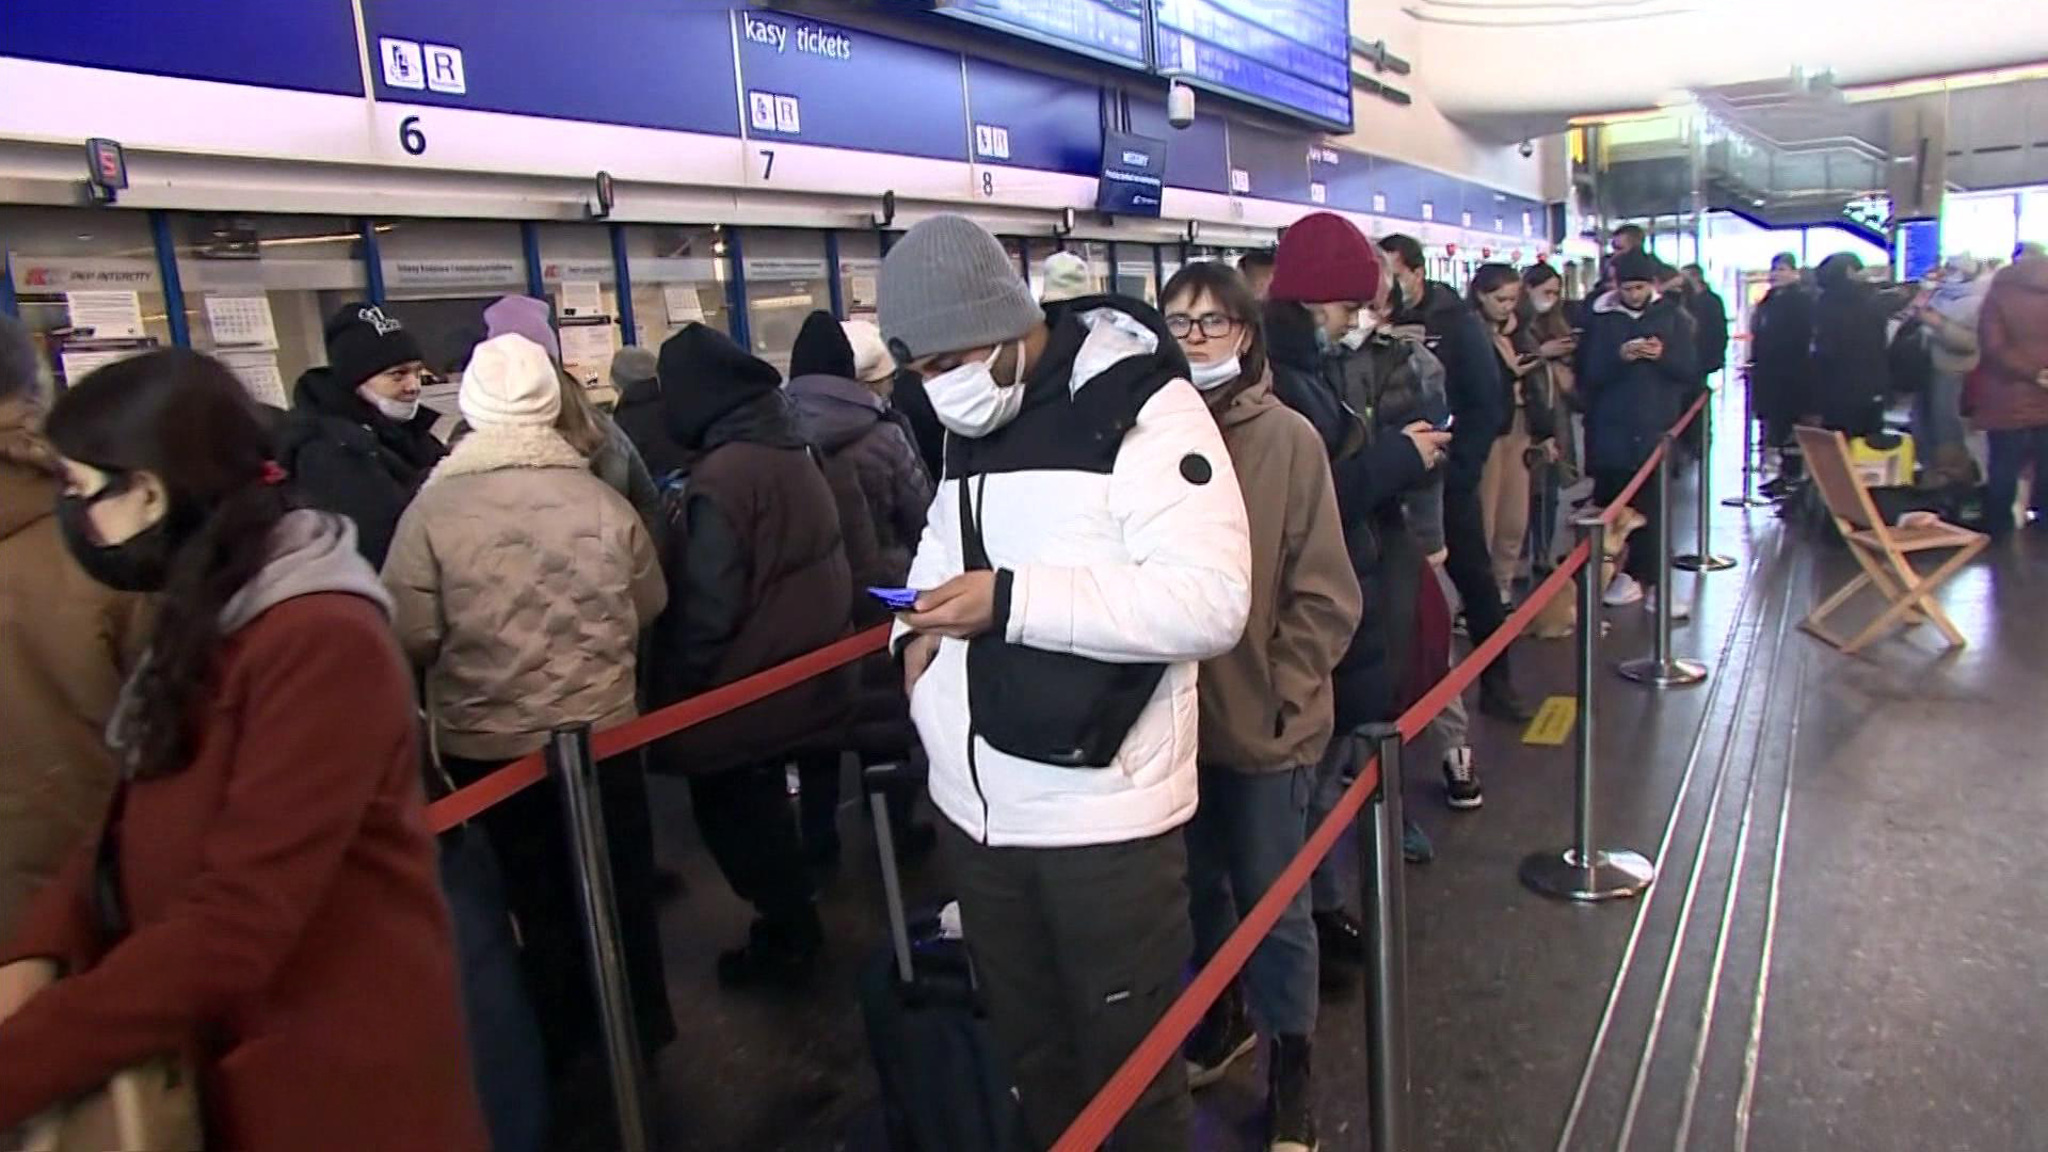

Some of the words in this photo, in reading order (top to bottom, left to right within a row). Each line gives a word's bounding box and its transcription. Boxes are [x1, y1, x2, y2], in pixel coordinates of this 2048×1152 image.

[743, 11, 786, 53] kasy
[797, 26, 851, 60] tickets
[434, 52, 455, 80] R
[400, 115, 426, 156] 6
[760, 151, 775, 180] 7
[982, 171, 993, 197] 8
